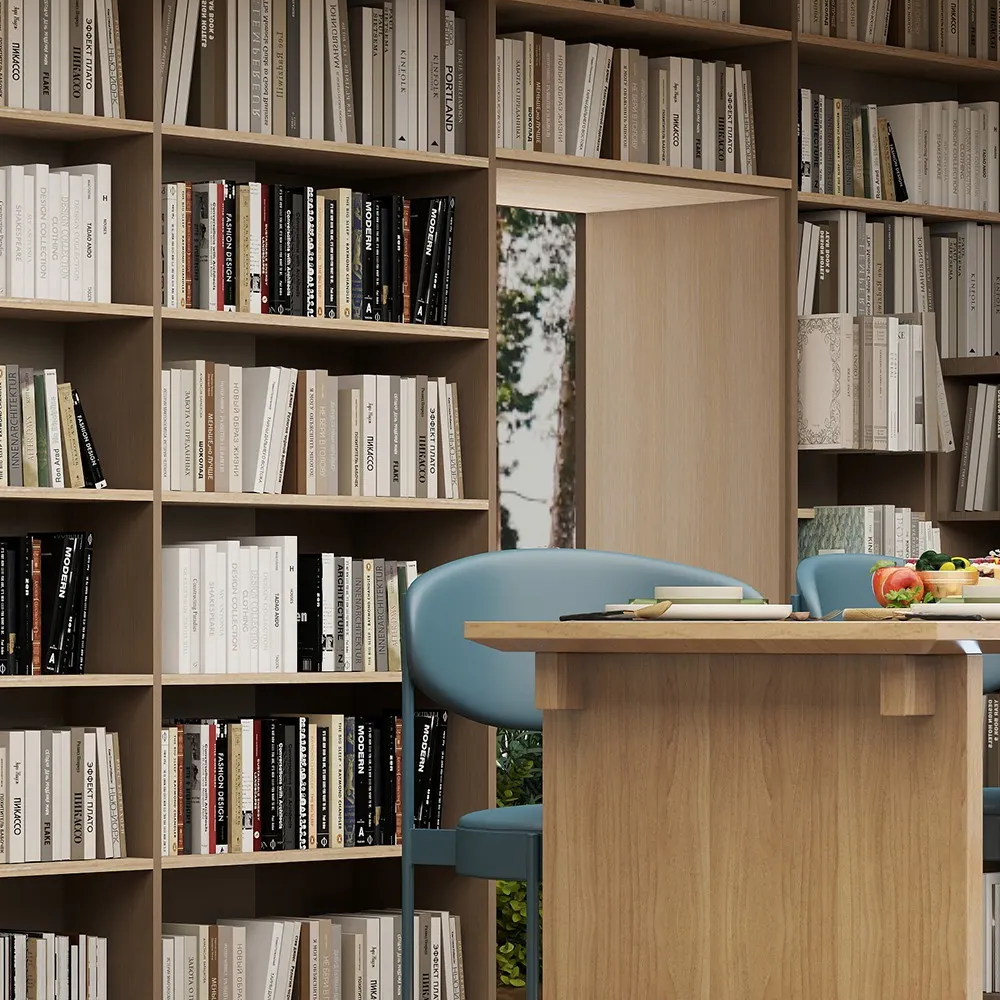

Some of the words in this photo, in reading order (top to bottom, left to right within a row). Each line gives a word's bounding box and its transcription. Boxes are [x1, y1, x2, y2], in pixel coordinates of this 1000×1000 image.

[73, 47, 81, 98] ПИКАССО
[426, 209, 437, 256] MODERN
[9, 373, 19, 469] INNENARCHITEKTUR
[78, 415, 89, 441] FASHION
[86, 443, 96, 466] DESIGN
[59, 547, 72, 598] MODERN
[376, 566, 385, 654] INNENARCHITEKTUR
[418, 724, 430, 772] MODERN
[74, 792, 82, 844] ПИКАССО
